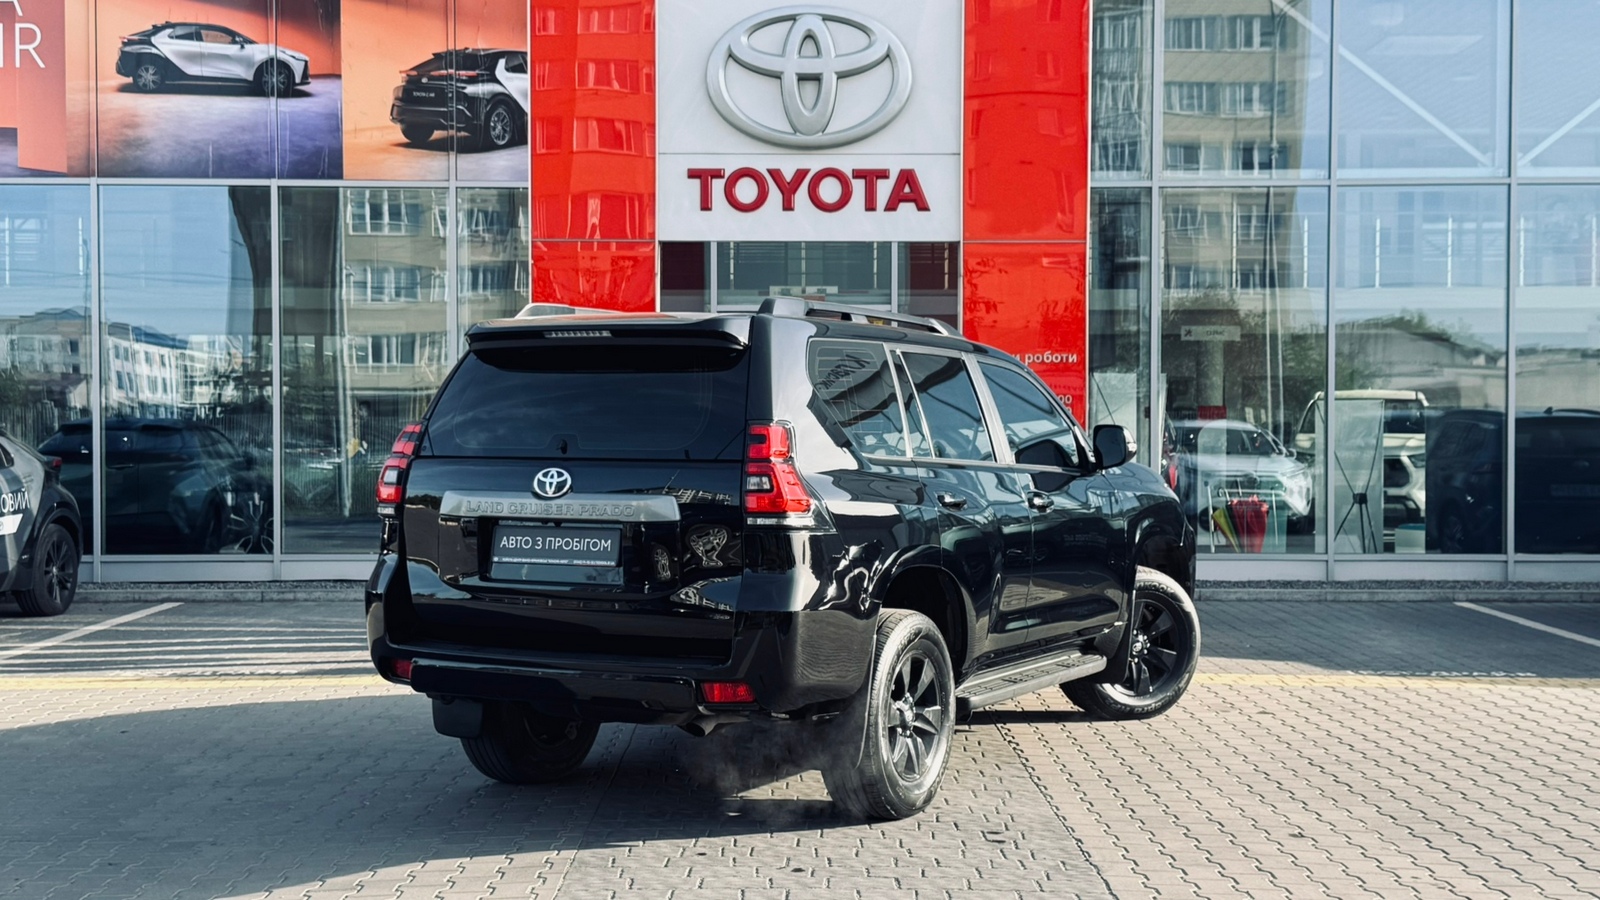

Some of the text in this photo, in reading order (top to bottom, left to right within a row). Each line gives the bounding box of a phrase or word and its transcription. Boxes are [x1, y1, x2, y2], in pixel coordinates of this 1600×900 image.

[687, 167, 931, 213] TOYOTA
[1025, 350, 1077, 366] роботи
[466, 500, 635, 517] LAND CRUISER PRADO
[500, 536, 533, 549] АВТО
[545, 537, 612, 551] ПРОБІГОМ
